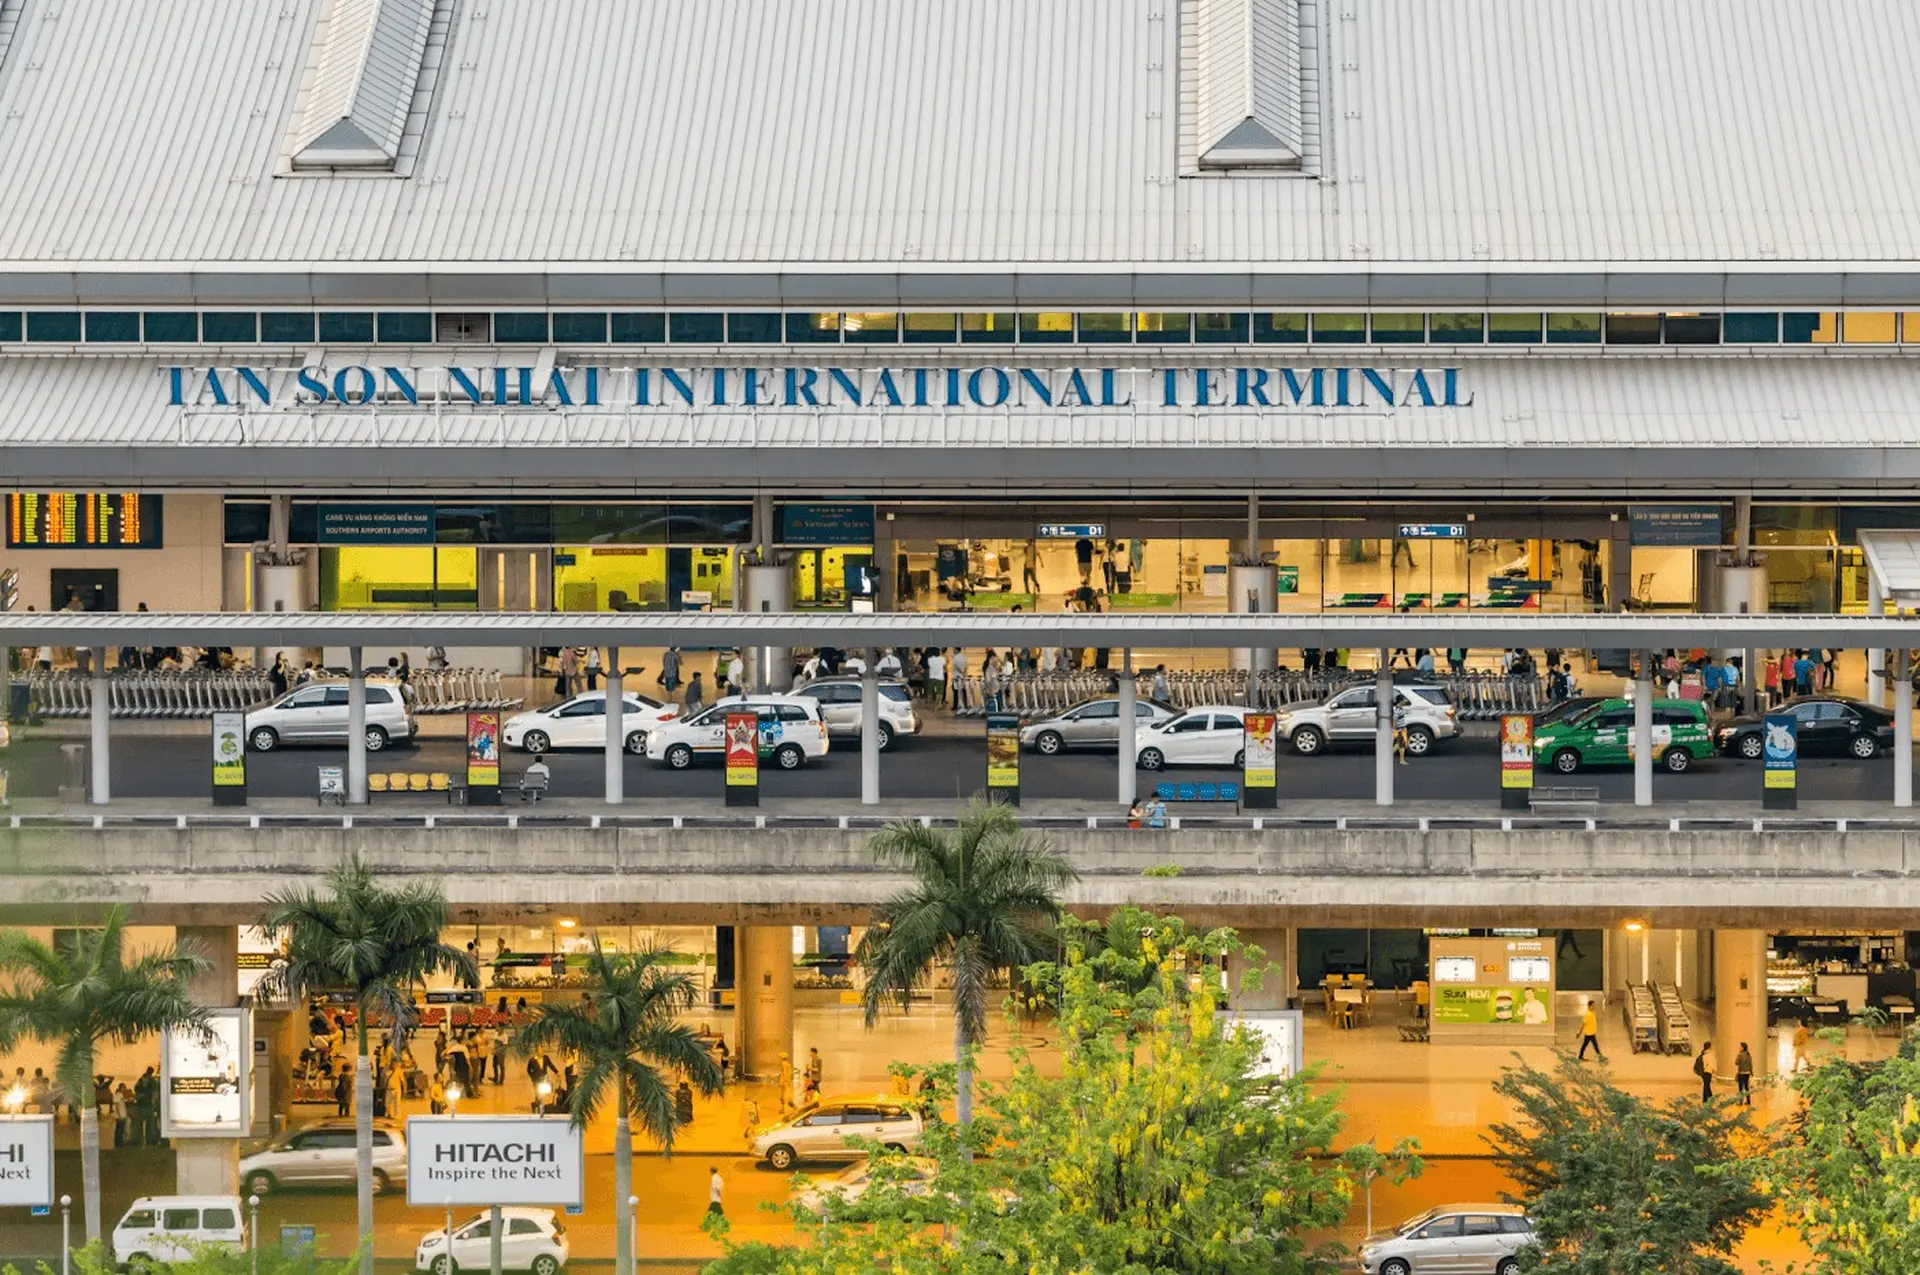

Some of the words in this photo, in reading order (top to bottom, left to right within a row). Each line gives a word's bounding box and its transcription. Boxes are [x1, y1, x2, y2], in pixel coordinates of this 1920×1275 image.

[157, 366, 275, 407] TAN
[296, 365, 432, 407] SON
[447, 366, 612, 407] NHAT
[631, 366, 1132, 408] INTERNATIONAL
[1151, 366, 1476, 408] TERMINAL
[325, 526, 359, 534] SOUTHERN
[392, 526, 428, 534] AUTHORITY
[1089, 526, 1102, 535] D1
[1450, 526, 1463, 535] D1
[435, 1143, 555, 1163] HITACHI
[428, 1166, 486, 1183] Inspire
[491, 1166, 517, 1180] the
[523, 1164, 562, 1180] Next
